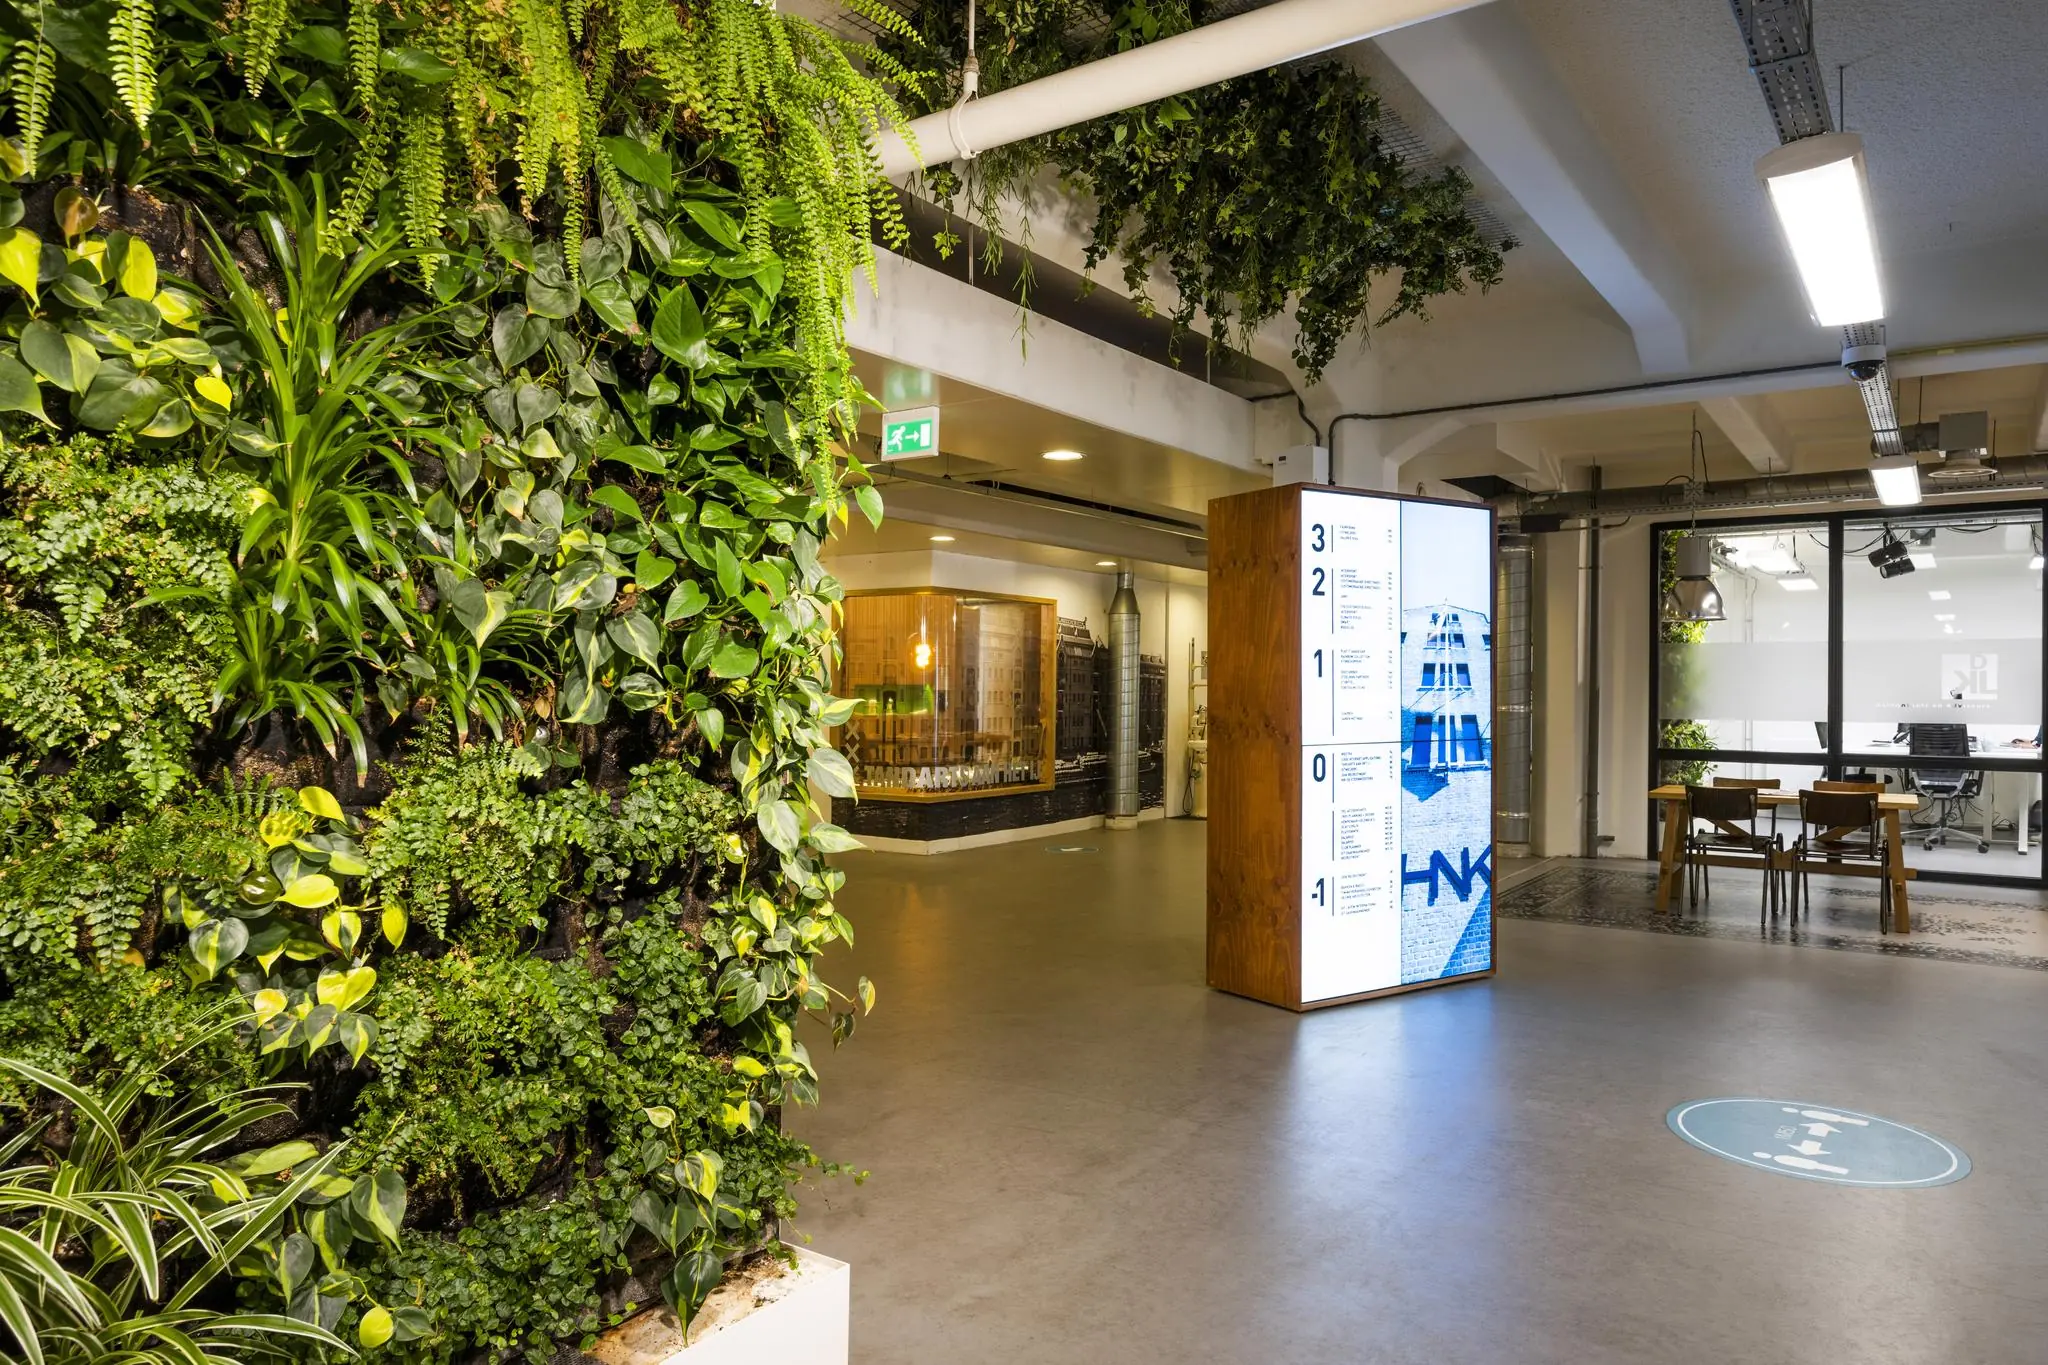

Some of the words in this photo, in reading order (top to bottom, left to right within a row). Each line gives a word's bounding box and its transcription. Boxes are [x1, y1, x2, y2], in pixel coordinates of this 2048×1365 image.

[1311, 523, 1326, 553] 3
[1312, 567, 1326, 597] 2
[1313, 649, 1323, 678] 1
[864, 765, 970, 788] TANDARTS
[1313, 753, 1326, 783] 0
[1401, 845, 1491, 907] HNK
[1311, 877, 1325, 907] -1
